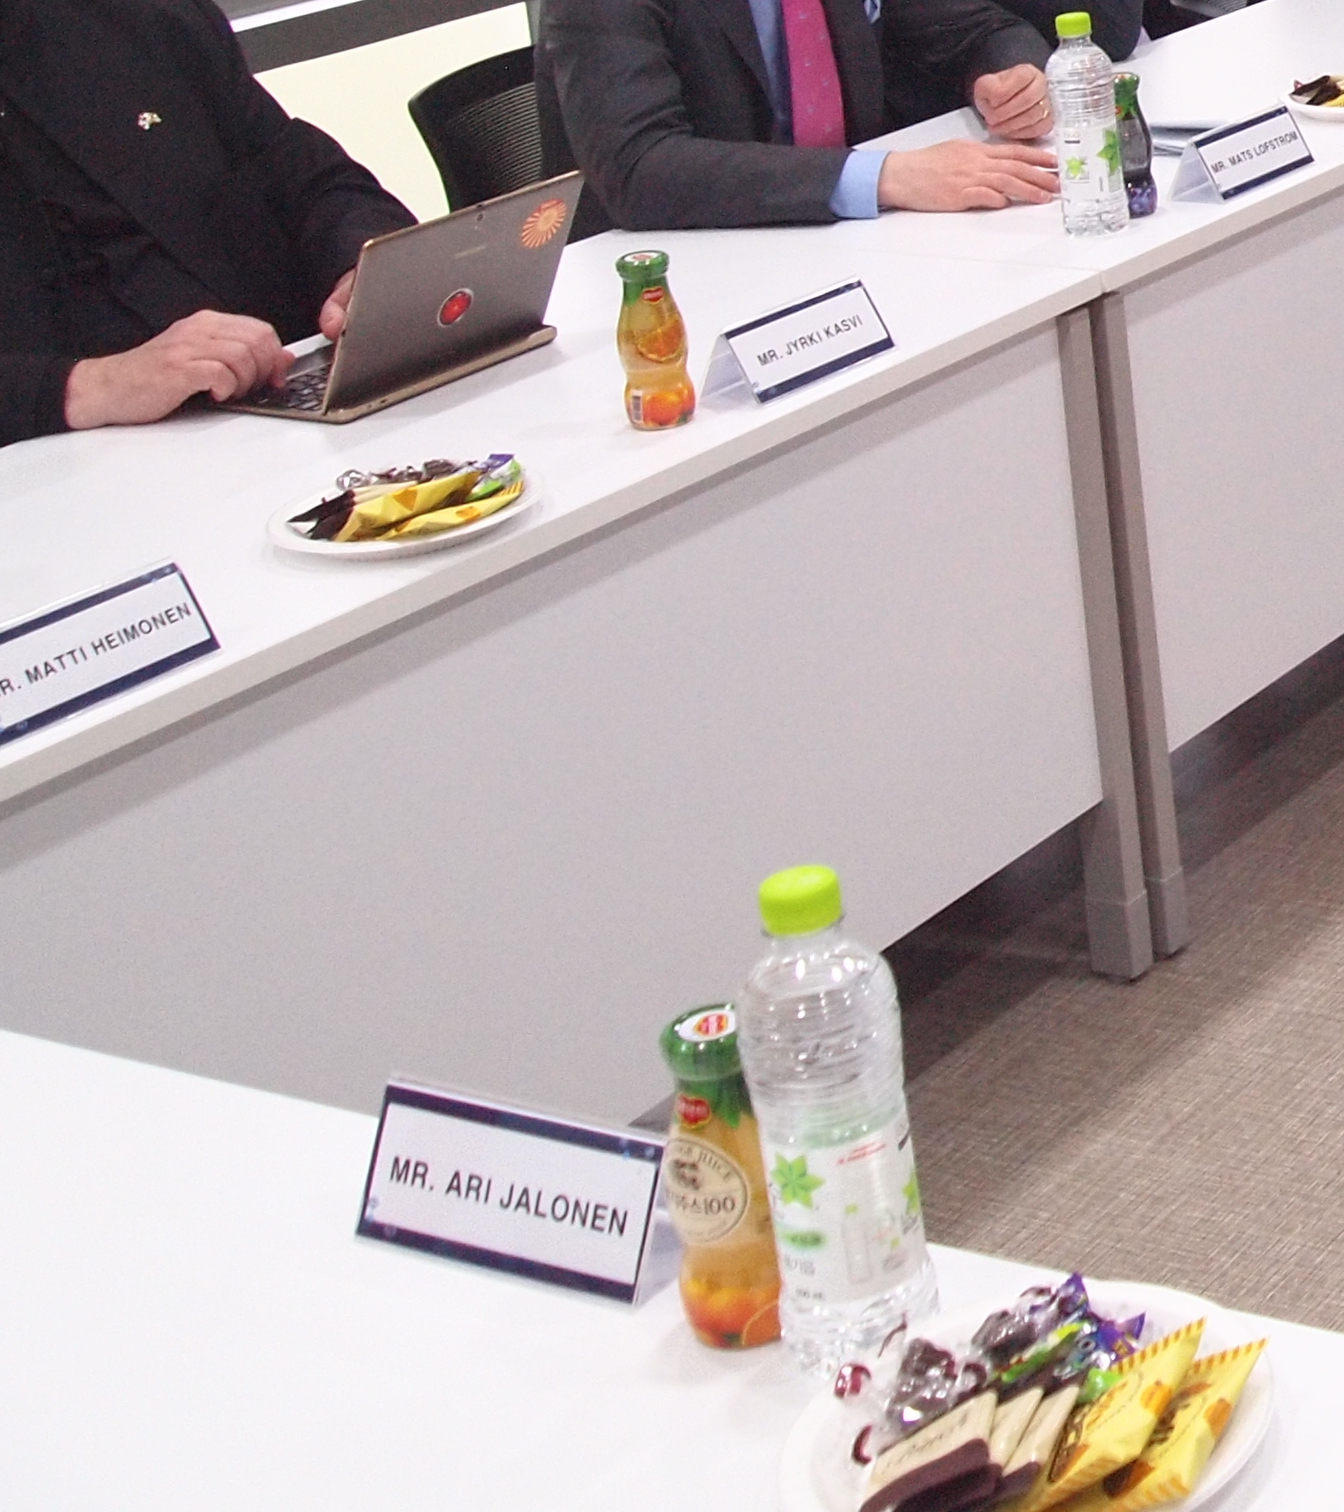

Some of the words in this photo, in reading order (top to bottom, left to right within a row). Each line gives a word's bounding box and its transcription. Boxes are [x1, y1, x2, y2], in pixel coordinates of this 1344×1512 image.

[1228, 149, 1254, 167] MATS
[757, 349, 784, 366] MR.
[785, 331, 823, 356] JYRKI
[823, 314, 863, 339] KASVI
[0, 679, 22, 698] R.
[25, 645, 88, 685] MATTI
[91, 602, 192, 656] HEIMONEN
[389, 1155, 435, 1192] MR.
[445, 1170, 493, 1205] ARI
[499, 1183, 629, 1238] JALONEN
